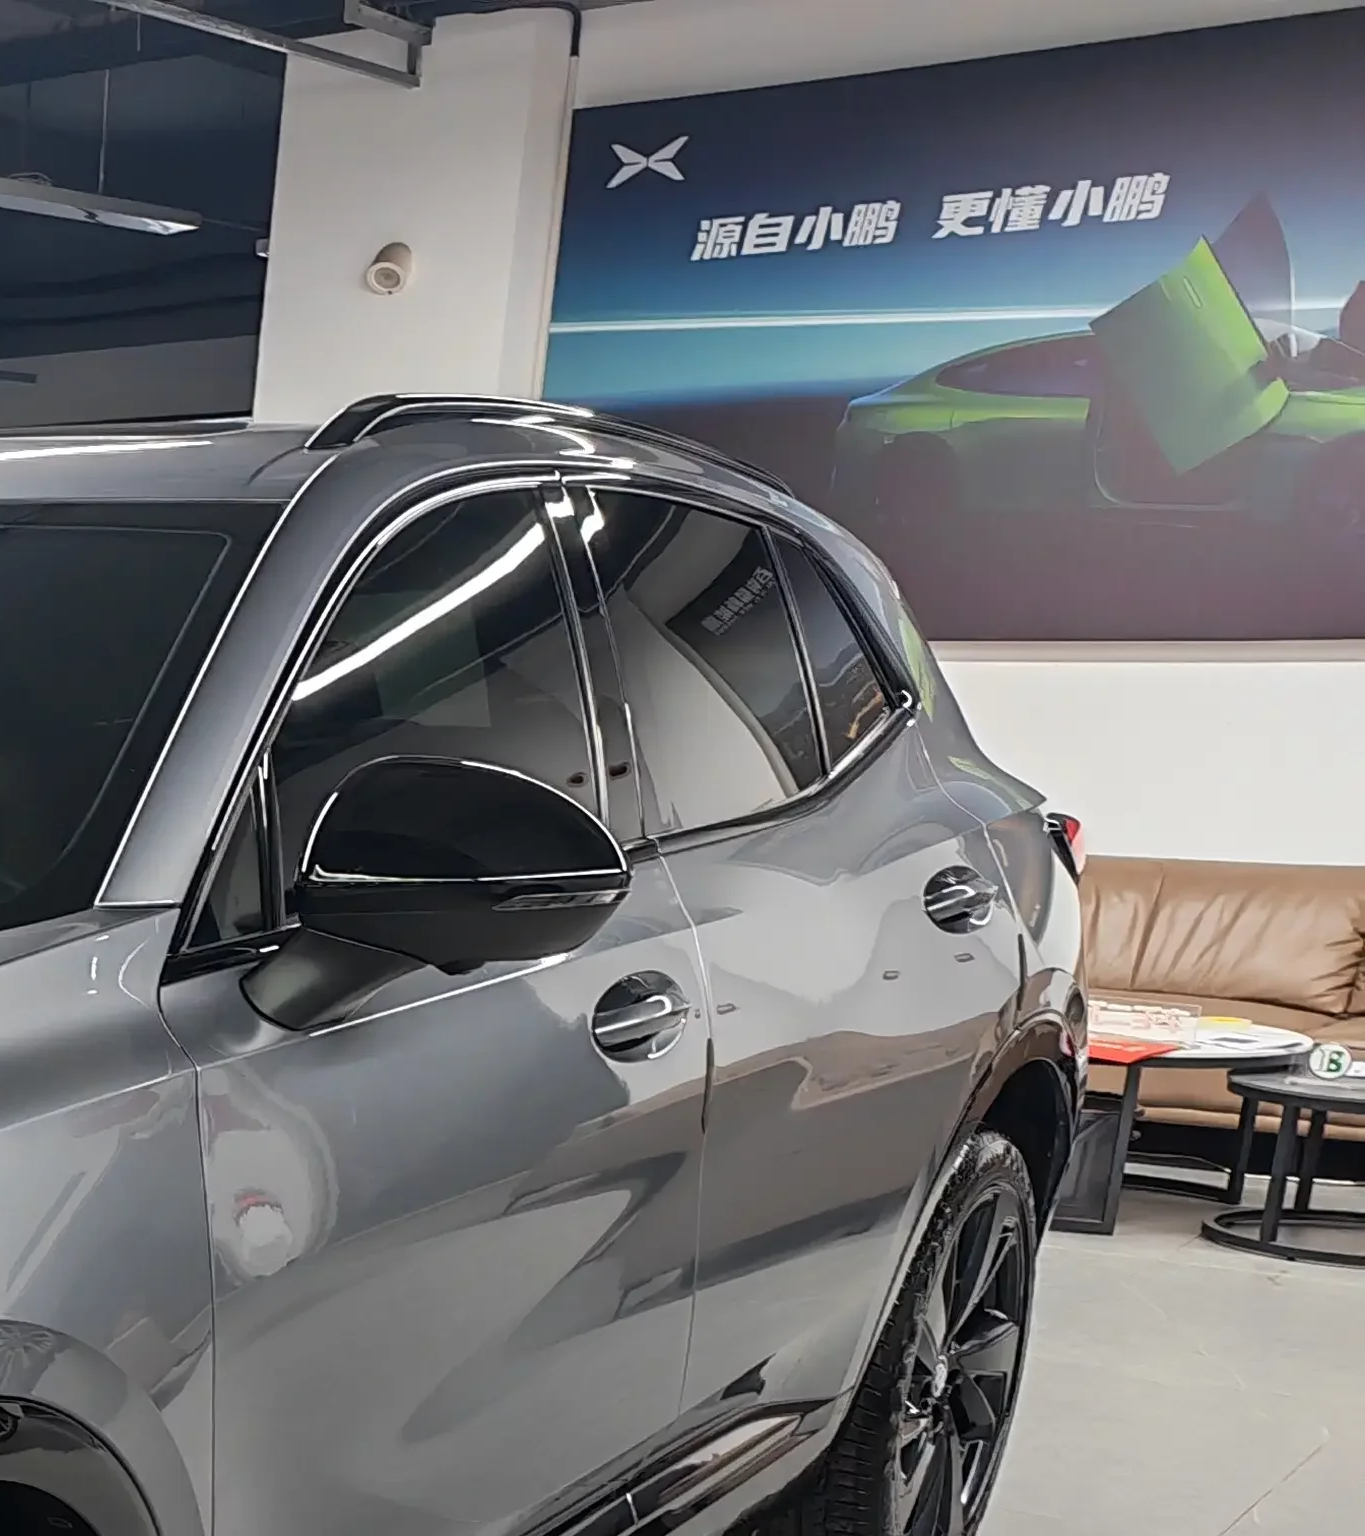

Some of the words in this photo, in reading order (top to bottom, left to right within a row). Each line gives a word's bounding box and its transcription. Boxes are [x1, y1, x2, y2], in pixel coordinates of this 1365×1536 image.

[691, 201, 900, 260] 源自小鹏
[933, 173, 1170, 238] 更懂小鹏
